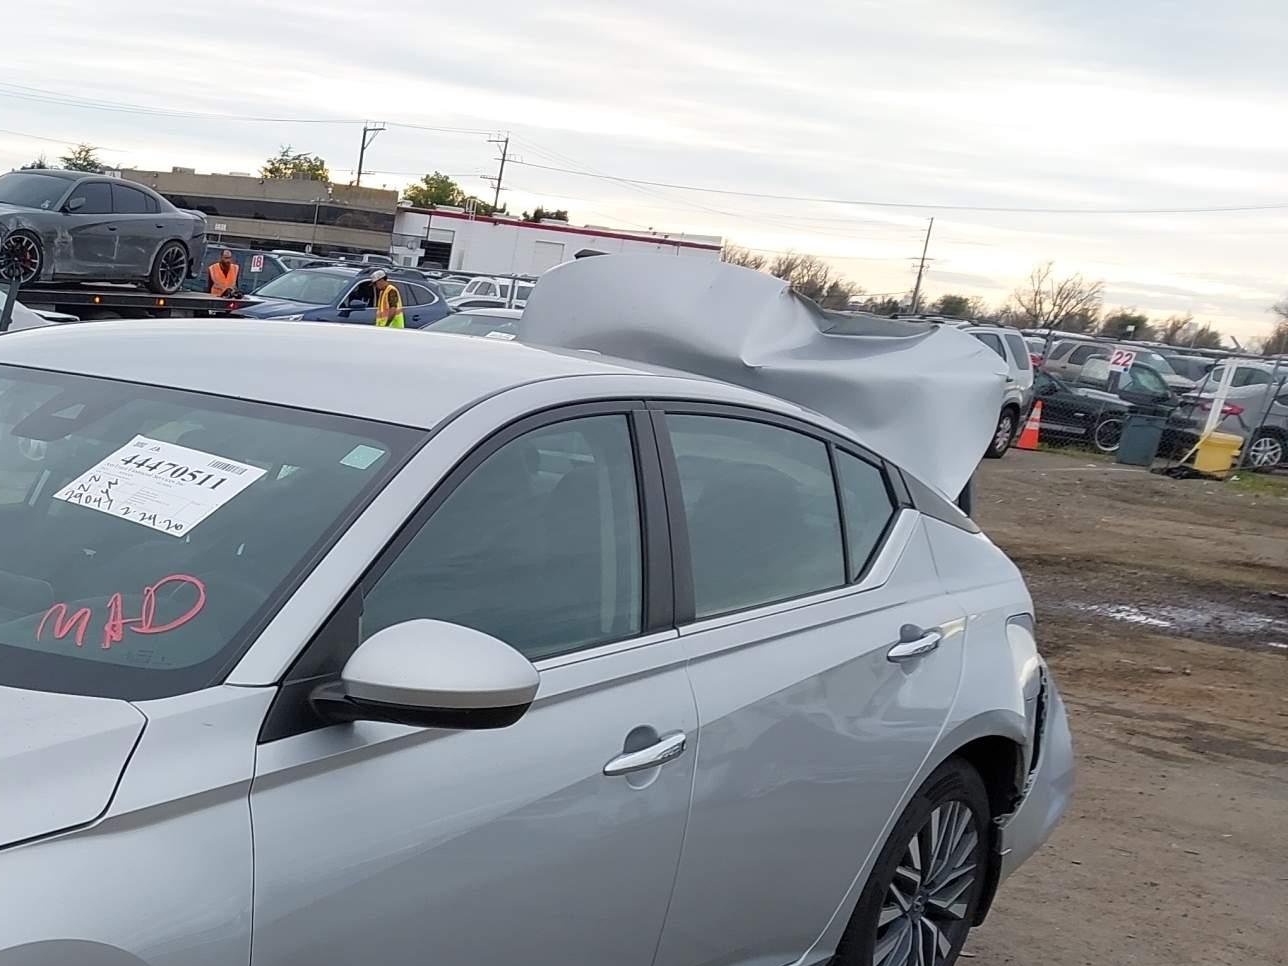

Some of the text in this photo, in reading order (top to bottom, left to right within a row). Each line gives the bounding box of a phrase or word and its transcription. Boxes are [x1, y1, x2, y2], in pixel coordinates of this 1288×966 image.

[252, 256, 263, 268] 18
[1112, 351, 1133, 367] 22
[121, 454, 227, 489] 44470511
[37, 574, 206, 649] MAD
